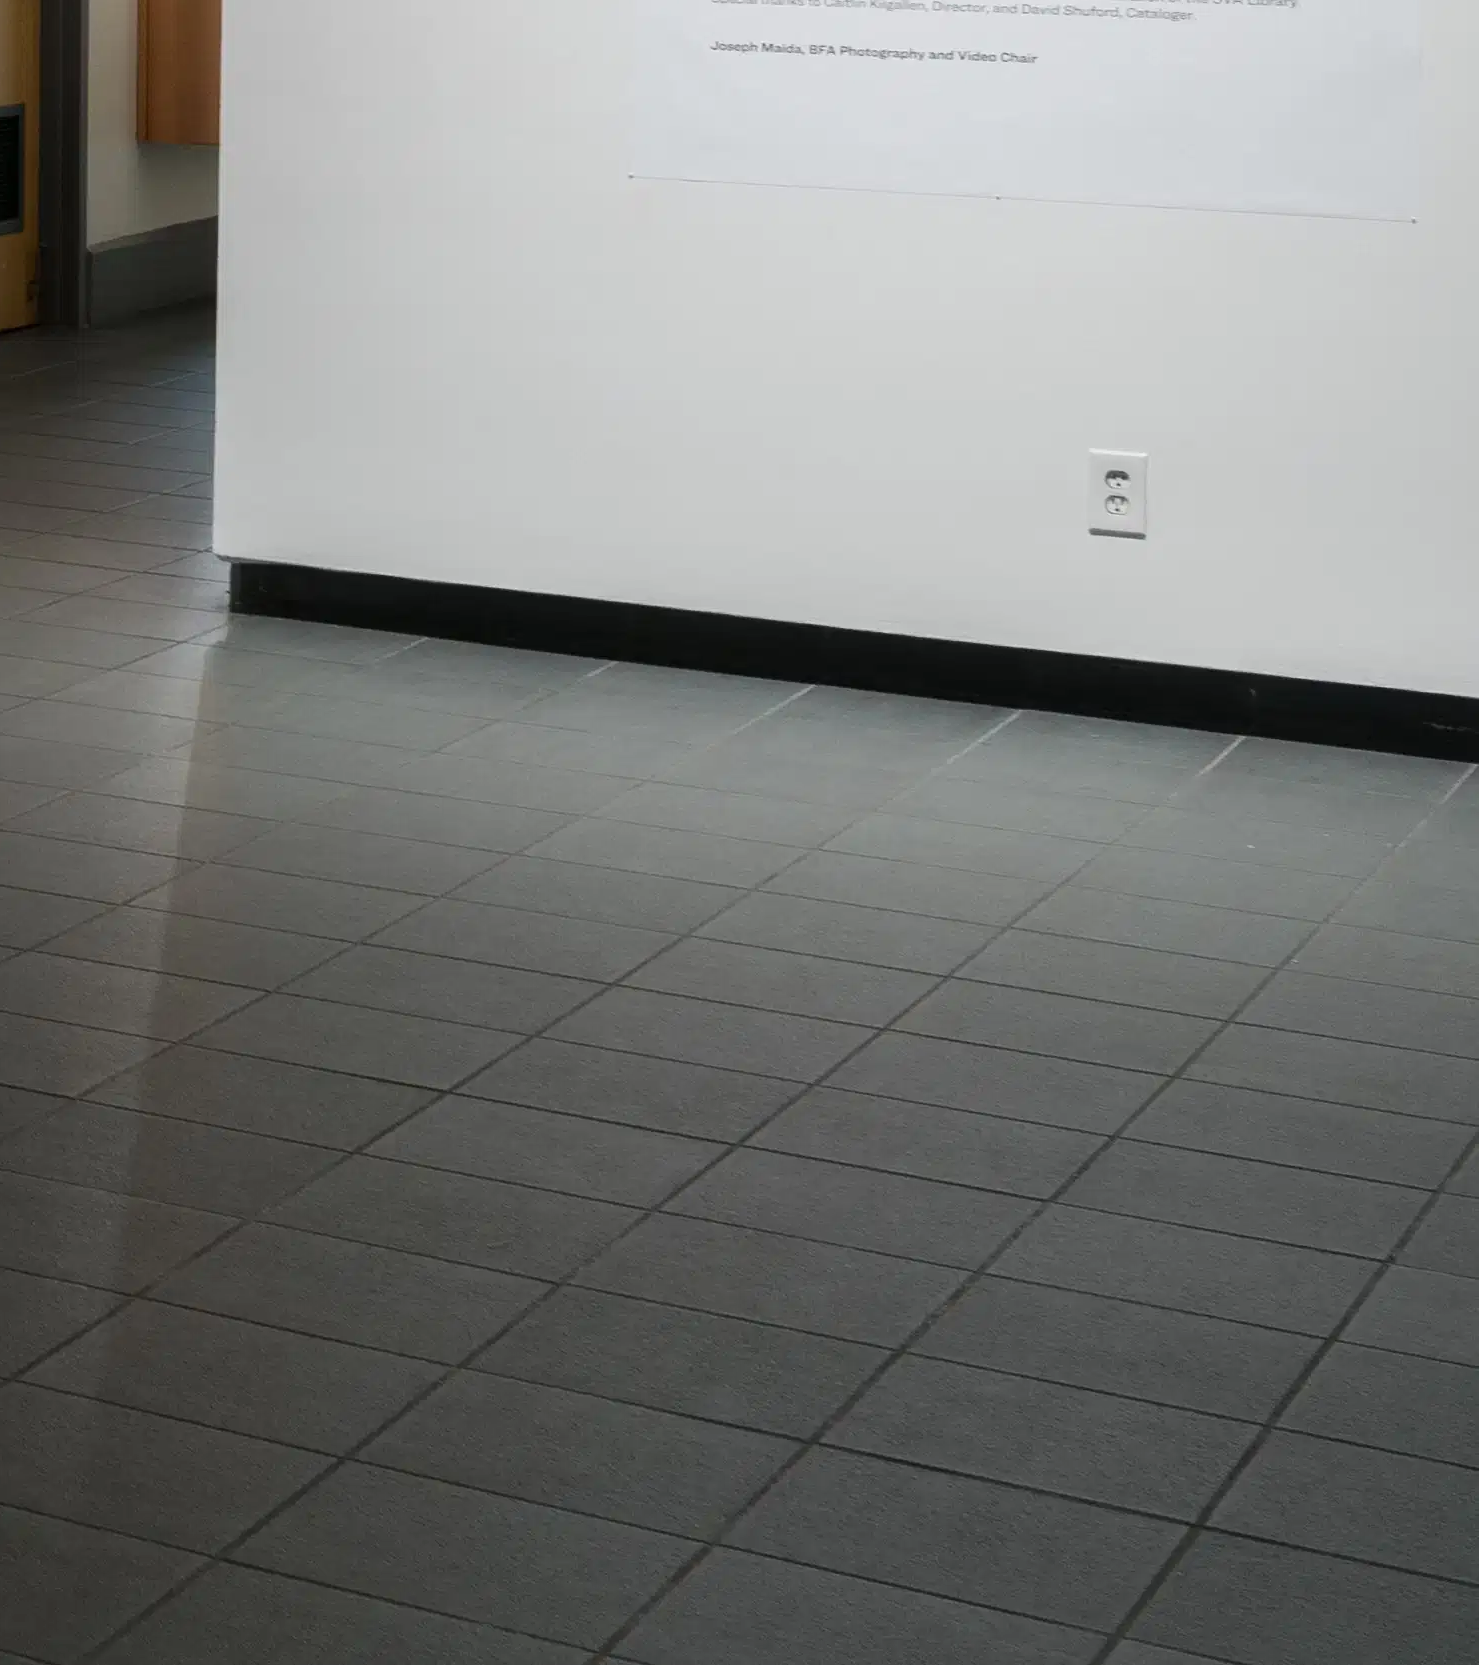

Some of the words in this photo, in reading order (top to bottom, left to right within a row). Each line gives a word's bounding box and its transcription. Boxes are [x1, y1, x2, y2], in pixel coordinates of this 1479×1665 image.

[709, 41, 758, 54] Joseph
[808, 45, 835, 55] BFA
[839, 46, 925, 61] Photography
[927, 49, 954, 60] and
[957, 51, 997, 62] Video
[999, 52, 1038, 63] Chair
